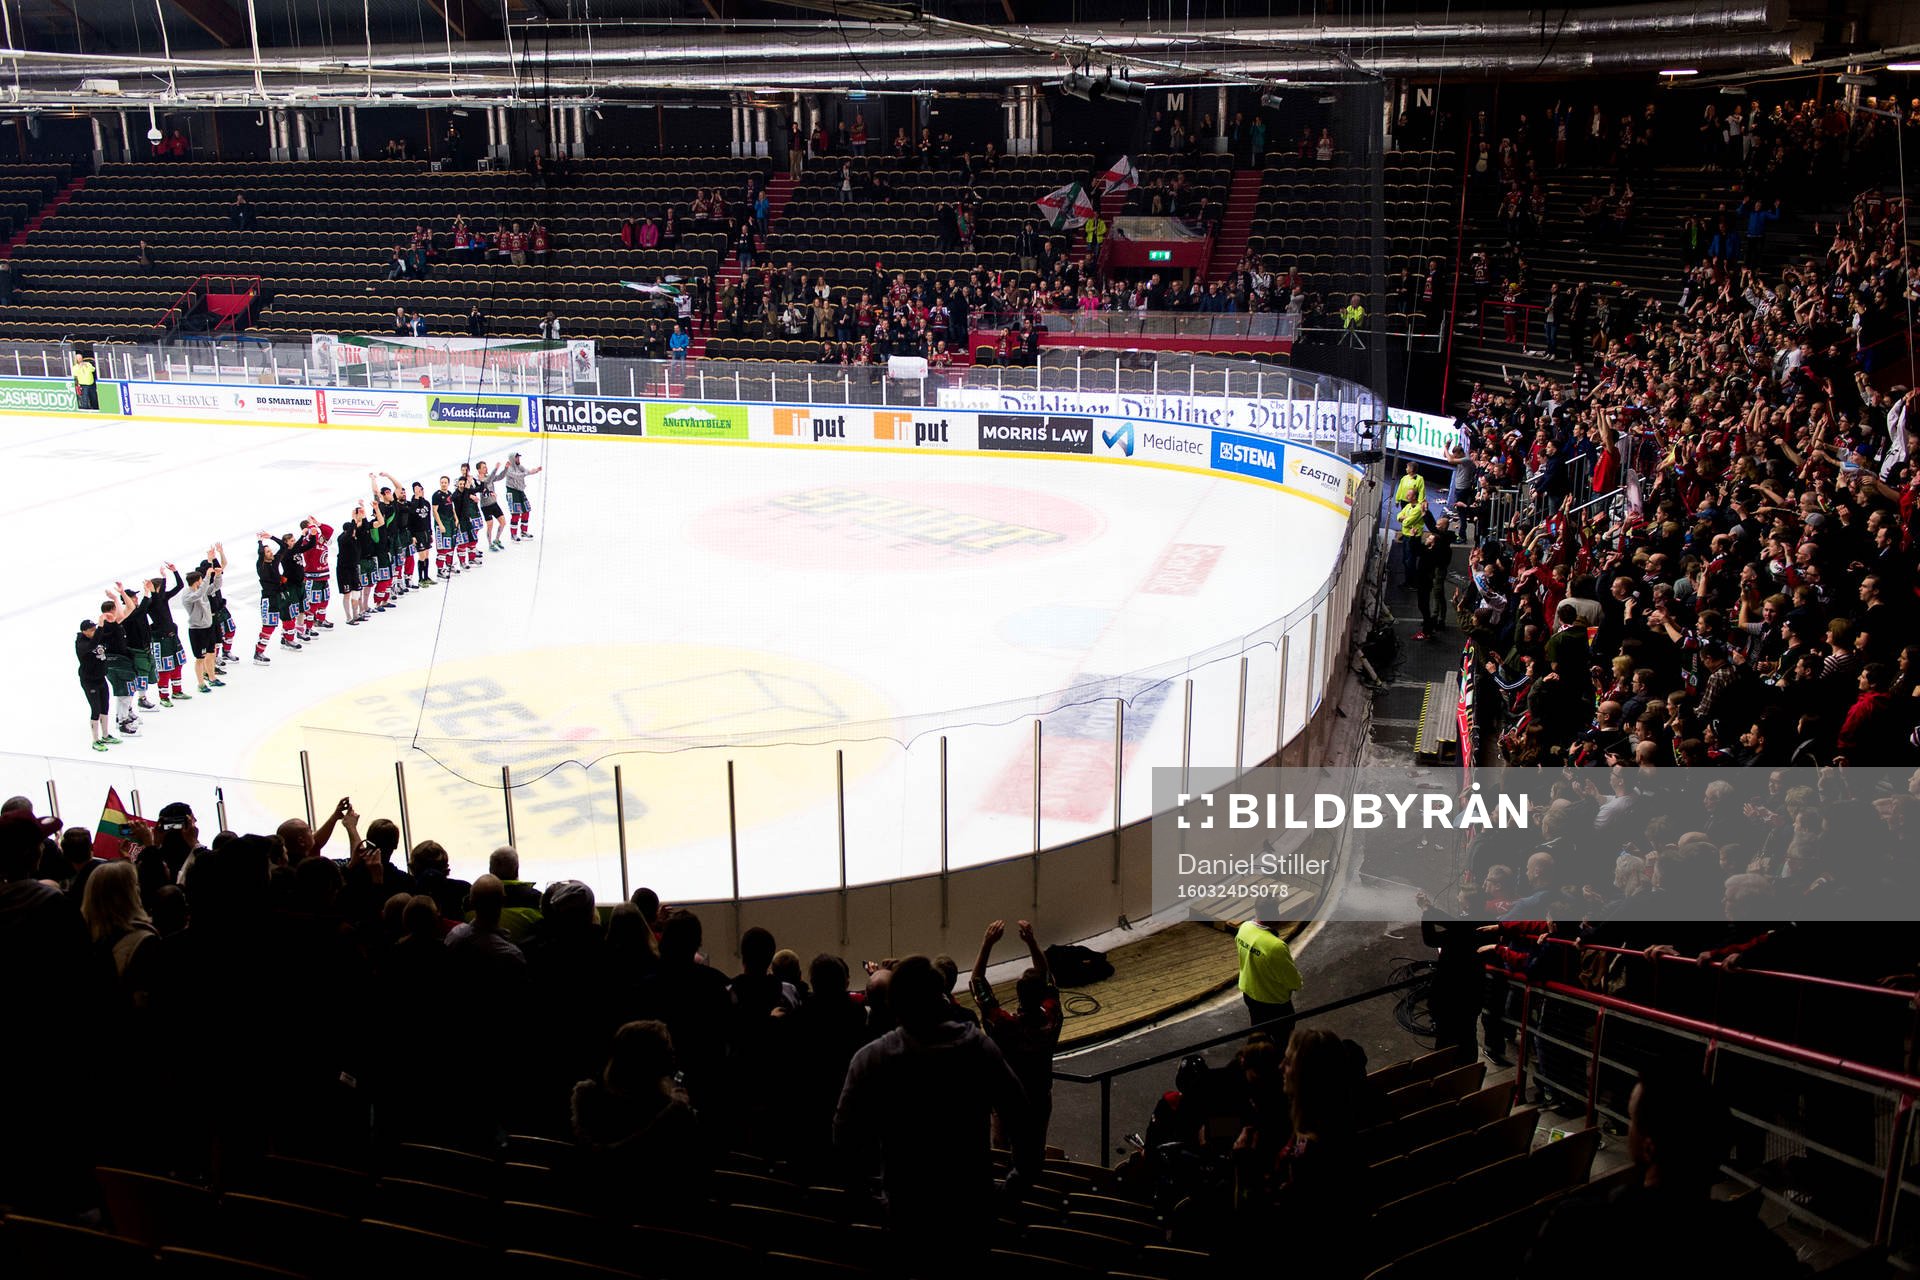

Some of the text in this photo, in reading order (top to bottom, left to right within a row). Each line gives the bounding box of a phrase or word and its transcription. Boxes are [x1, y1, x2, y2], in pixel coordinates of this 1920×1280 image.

[1168, 93, 1184, 111] M
[1417, 88, 1432, 107] N
[134, 394, 220, 407] TRAVEL SERVICE
[442, 406, 511, 419] Mattkillarna
[546, 401, 638, 426] midbec
[547, 424, 598, 433] WALLPAPERS
[983, 426, 1088, 442] MORRIS LAW
[1143, 432, 1204, 455] Mediatec
[1233, 447, 1276, 470] STENA
[1300, 466, 1340, 488] EASTON
